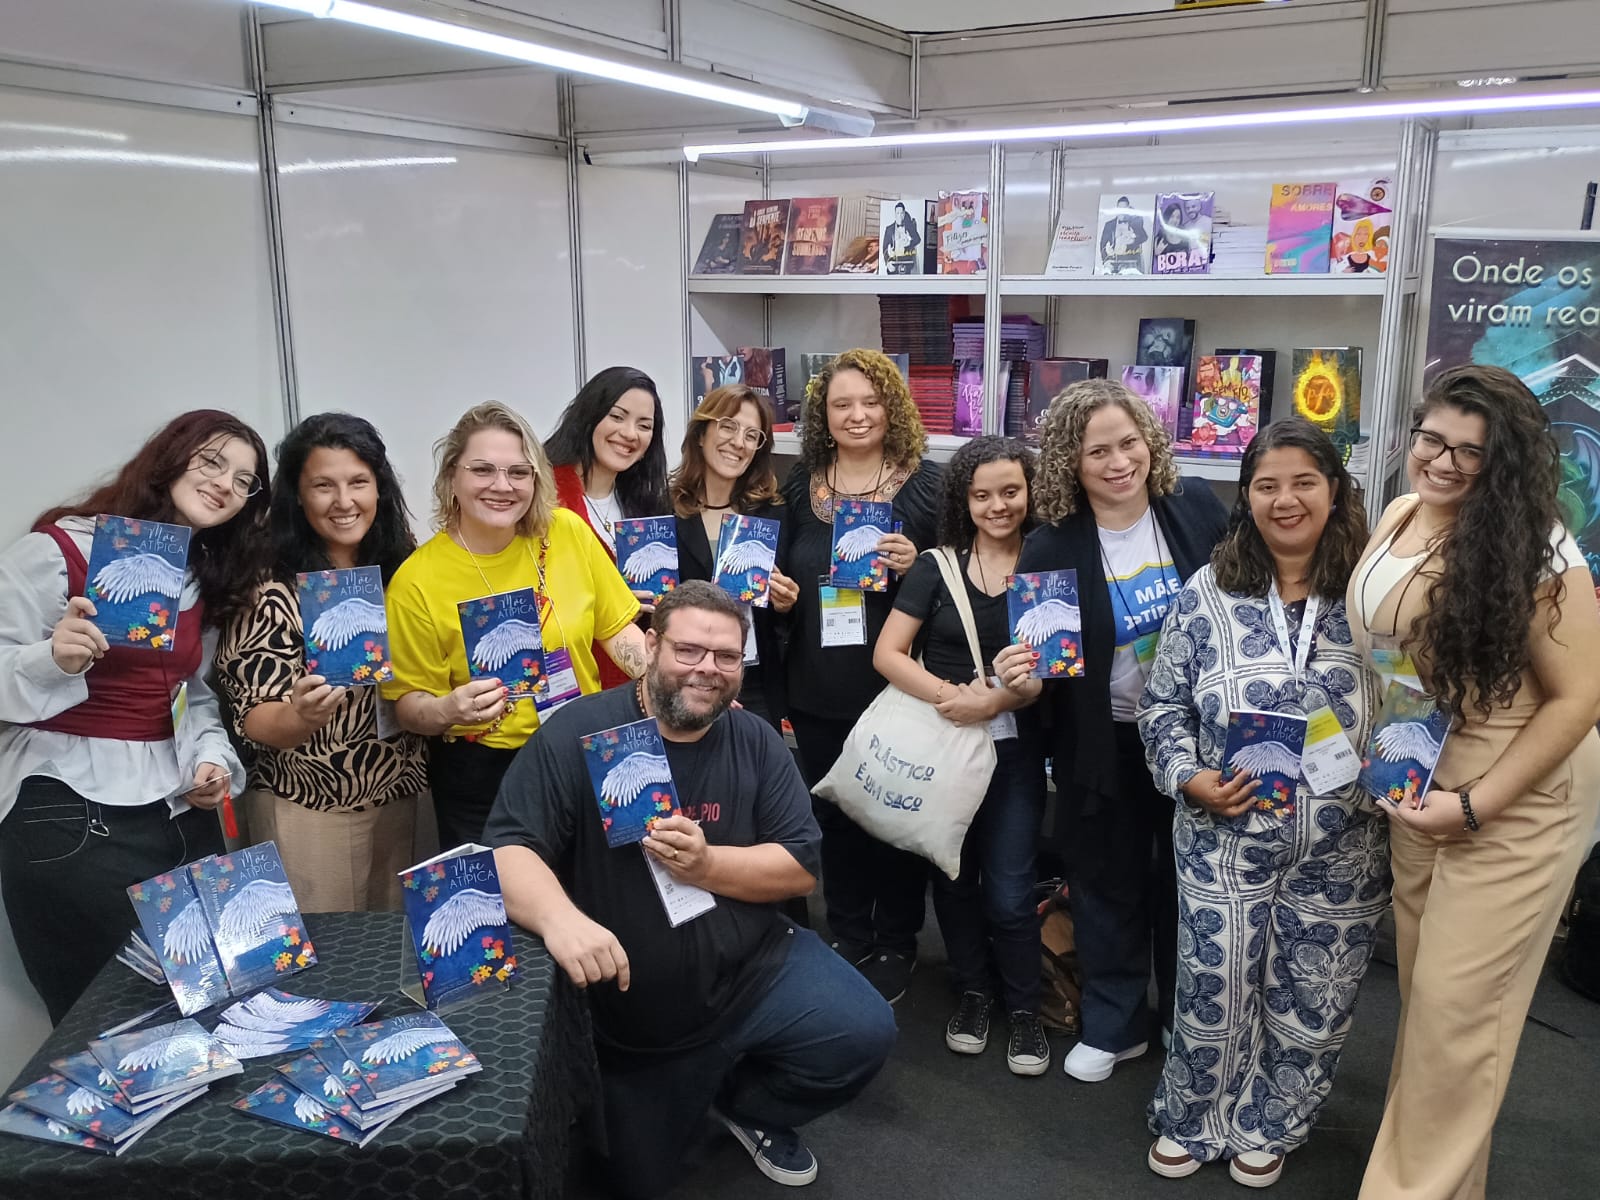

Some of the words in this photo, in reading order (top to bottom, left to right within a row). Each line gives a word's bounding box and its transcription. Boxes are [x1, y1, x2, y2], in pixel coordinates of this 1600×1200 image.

[1452, 255, 1544, 284] Onde
[1558, 266, 1593, 285] os
[1447, 297, 1532, 323] viram
[1135, 577, 1181, 605] MÃE
[869, 734, 935, 781] PLÁSTICO
[883, 790, 923, 812] SACO
